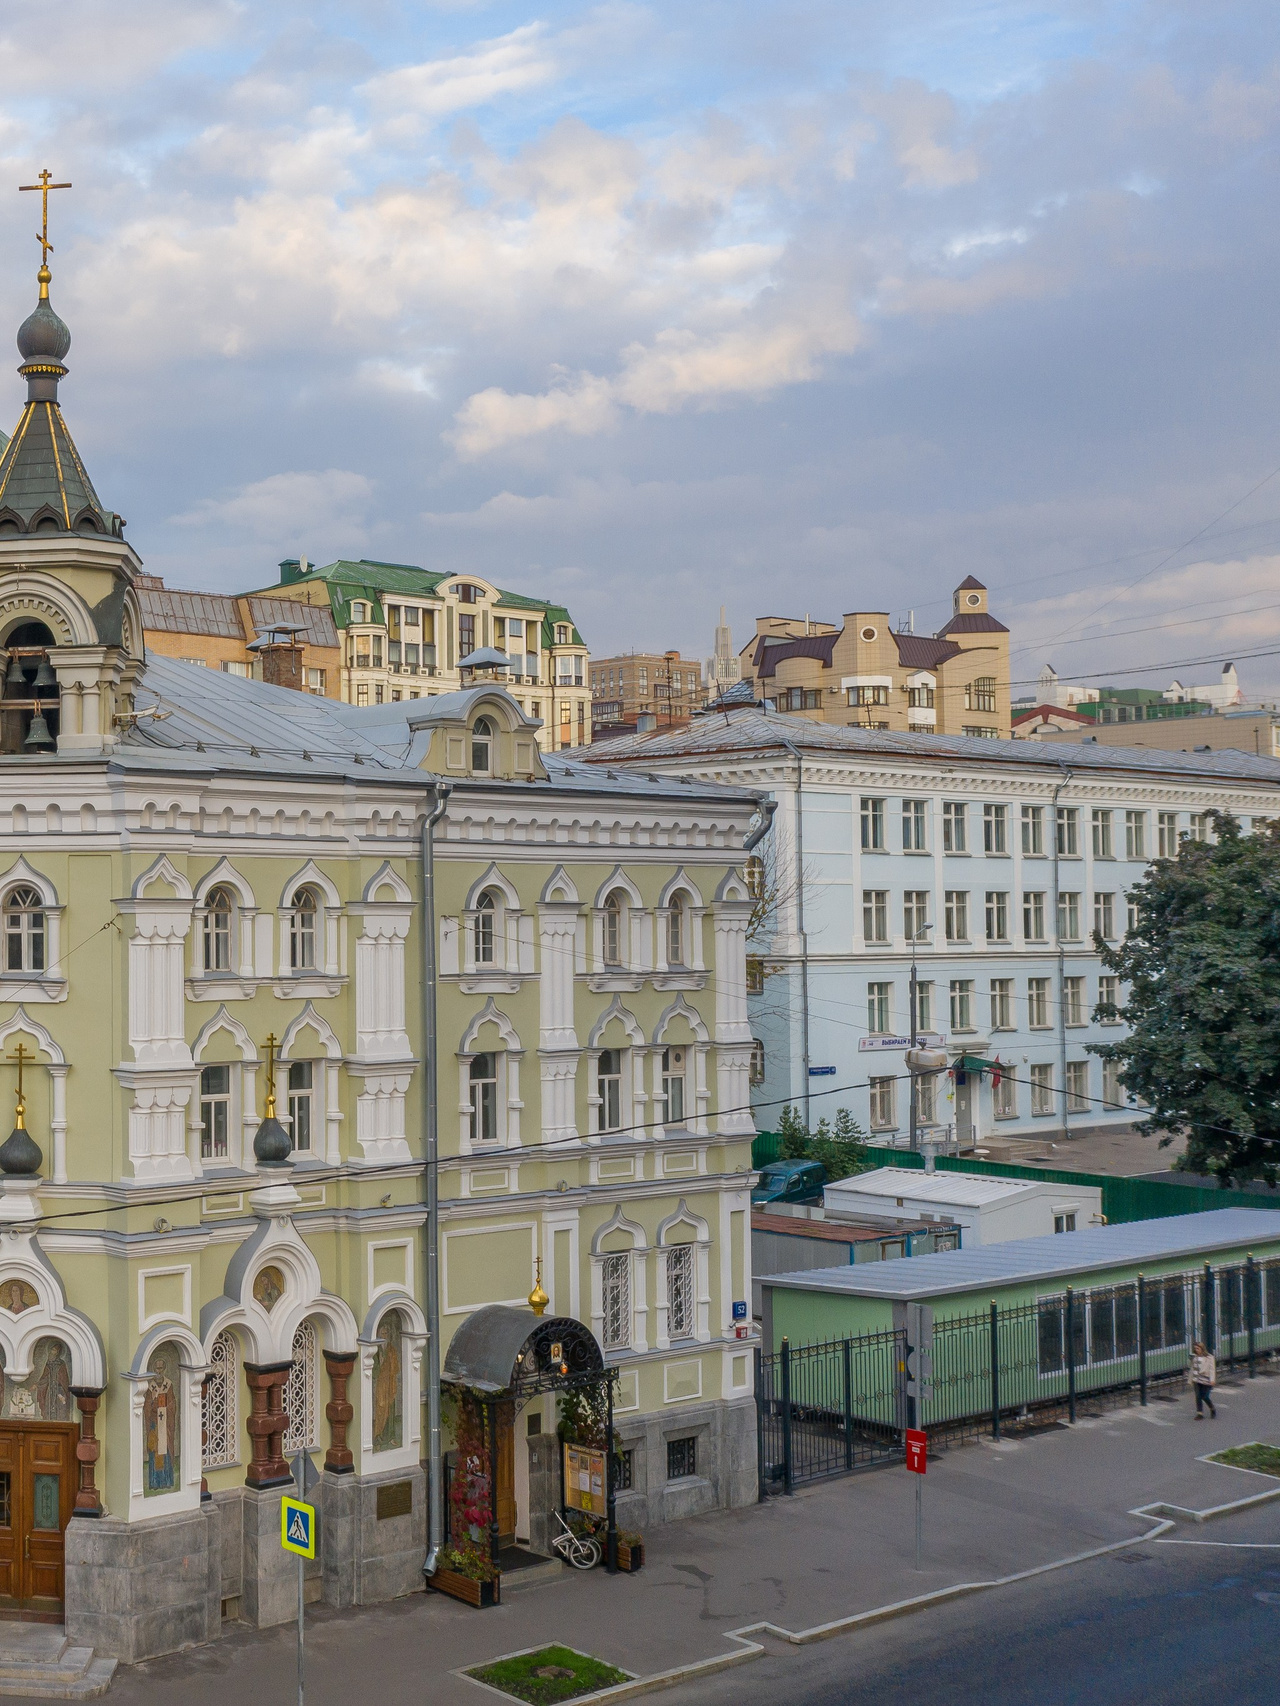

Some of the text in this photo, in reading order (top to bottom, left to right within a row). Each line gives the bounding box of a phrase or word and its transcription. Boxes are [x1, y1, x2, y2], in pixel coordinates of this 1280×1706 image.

[881, 1038, 907, 1046] ВЫБИРАЕМ
[907, 1037, 928, 1045] ВСТЕ!
[737, 1305, 746, 1314] 52
